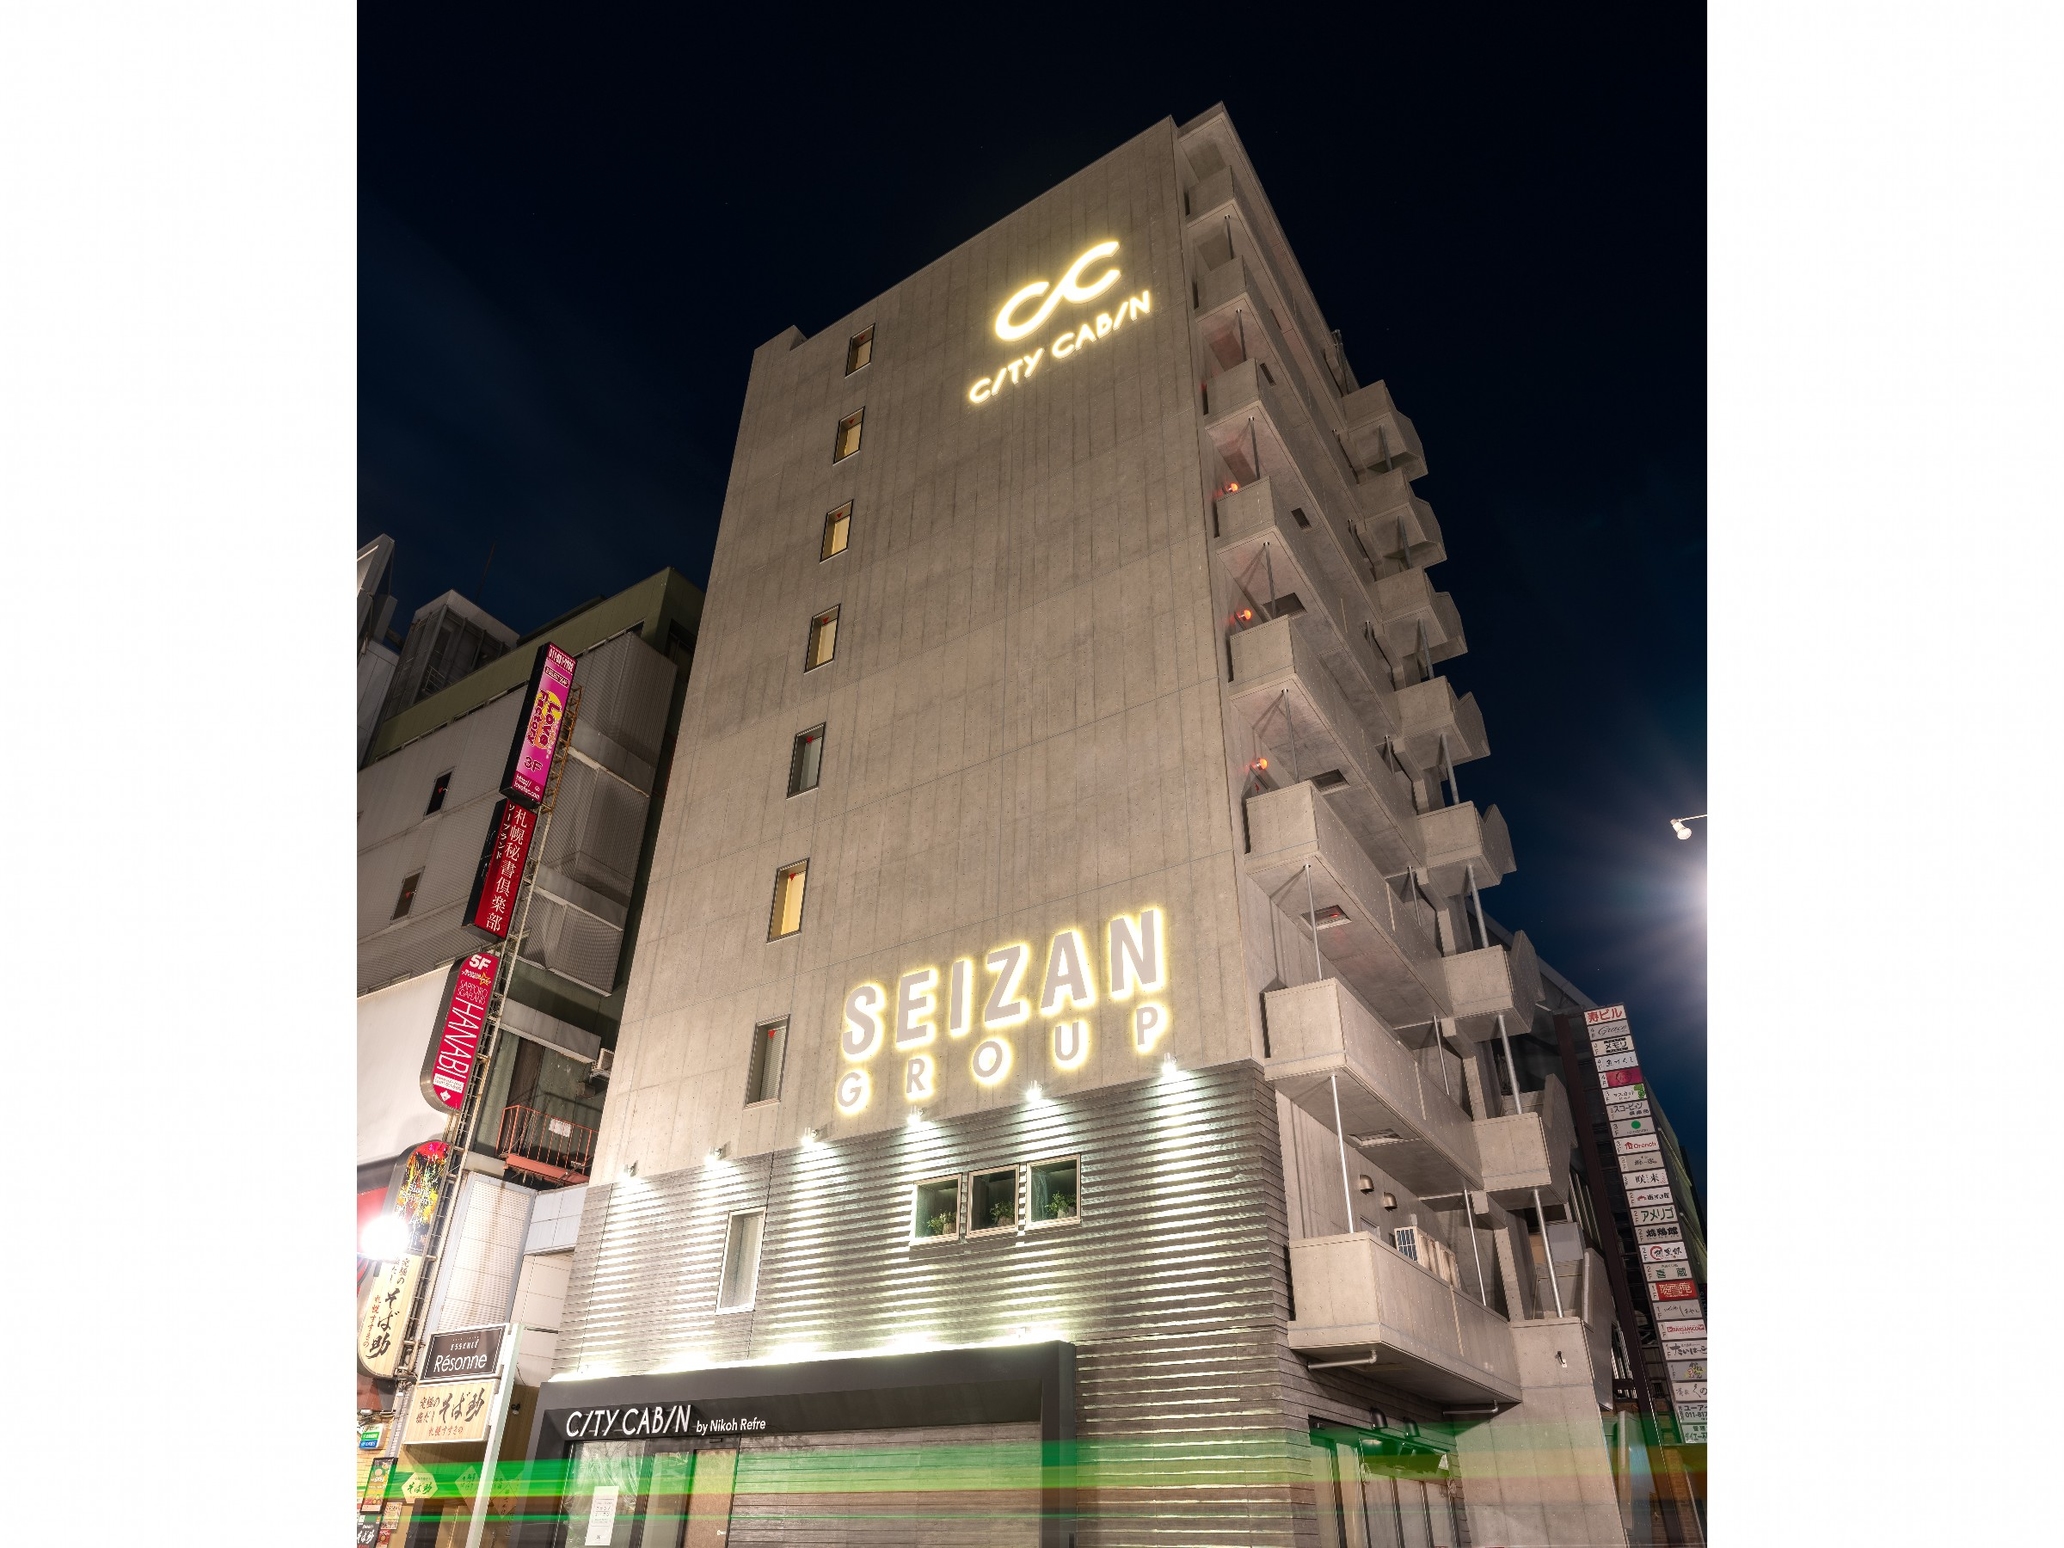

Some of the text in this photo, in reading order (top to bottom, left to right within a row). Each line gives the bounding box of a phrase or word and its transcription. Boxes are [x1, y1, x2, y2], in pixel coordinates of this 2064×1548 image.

[842, 907, 1166, 1058] SEIZAN
[436, 996, 485, 1079] HANABI
[836, 1003, 1168, 1110] GROUP
[433, 1353, 488, 1373] Résonne
[696, 1420, 709, 1436] by
[709, 1417, 738, 1432] Nikoh
[740, 1416, 766, 1431] Refre
